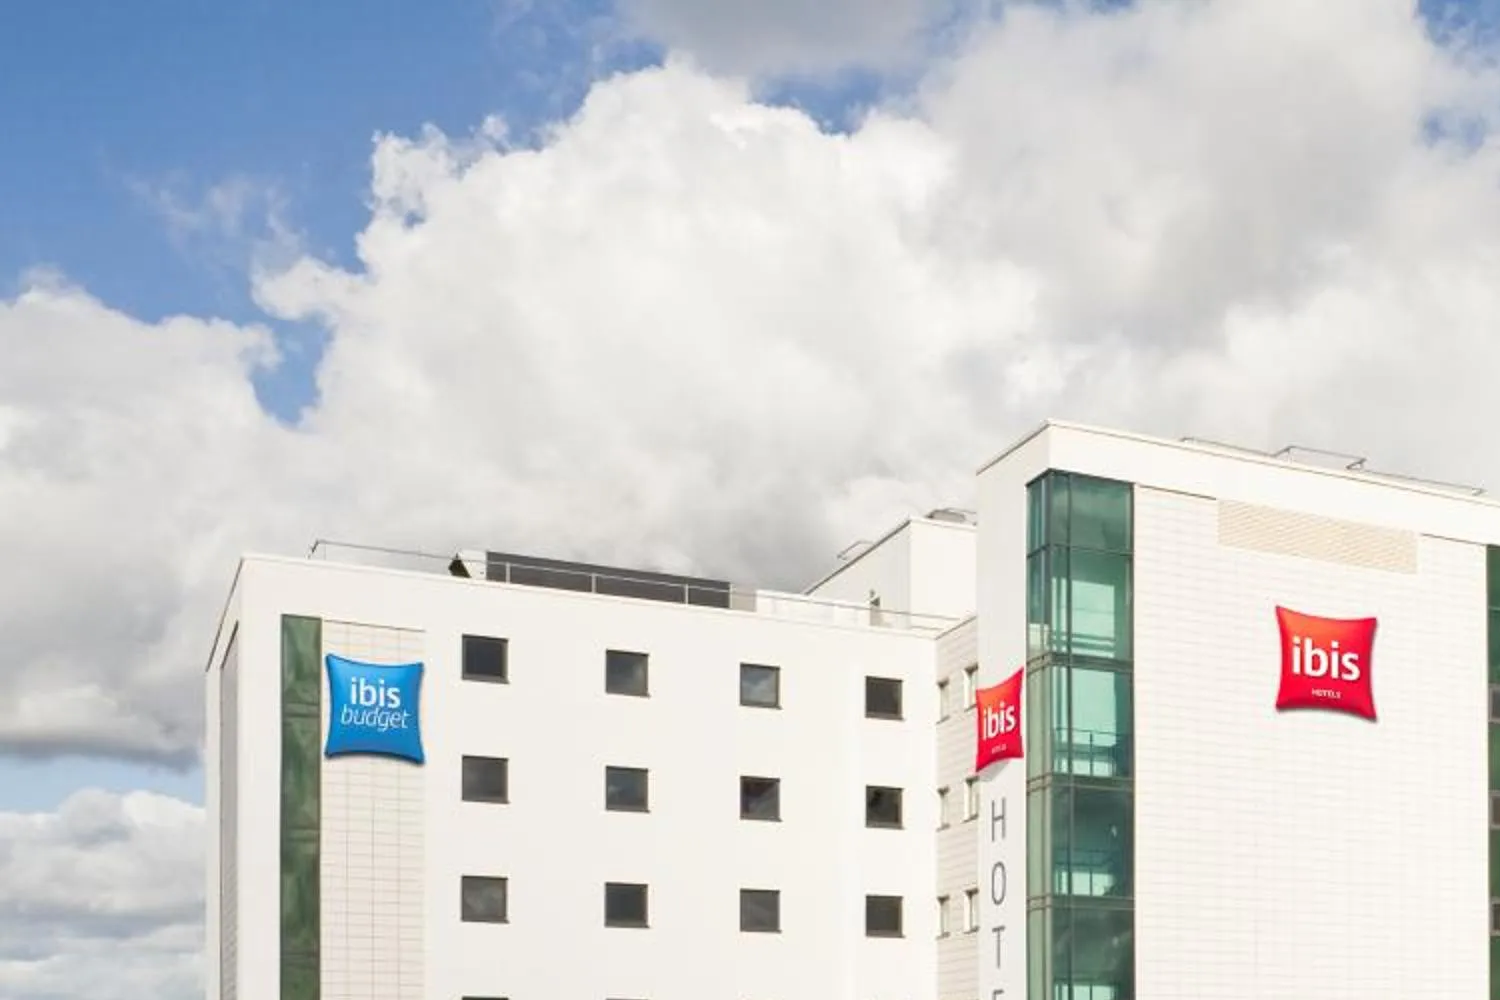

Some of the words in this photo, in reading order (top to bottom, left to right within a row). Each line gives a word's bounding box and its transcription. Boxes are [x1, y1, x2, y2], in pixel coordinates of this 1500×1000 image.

[1293, 635, 1360, 681] ibis
[351, 676, 401, 708] ibis
[341, 704, 411, 733] budget
[982, 700, 1017, 741] ibis
